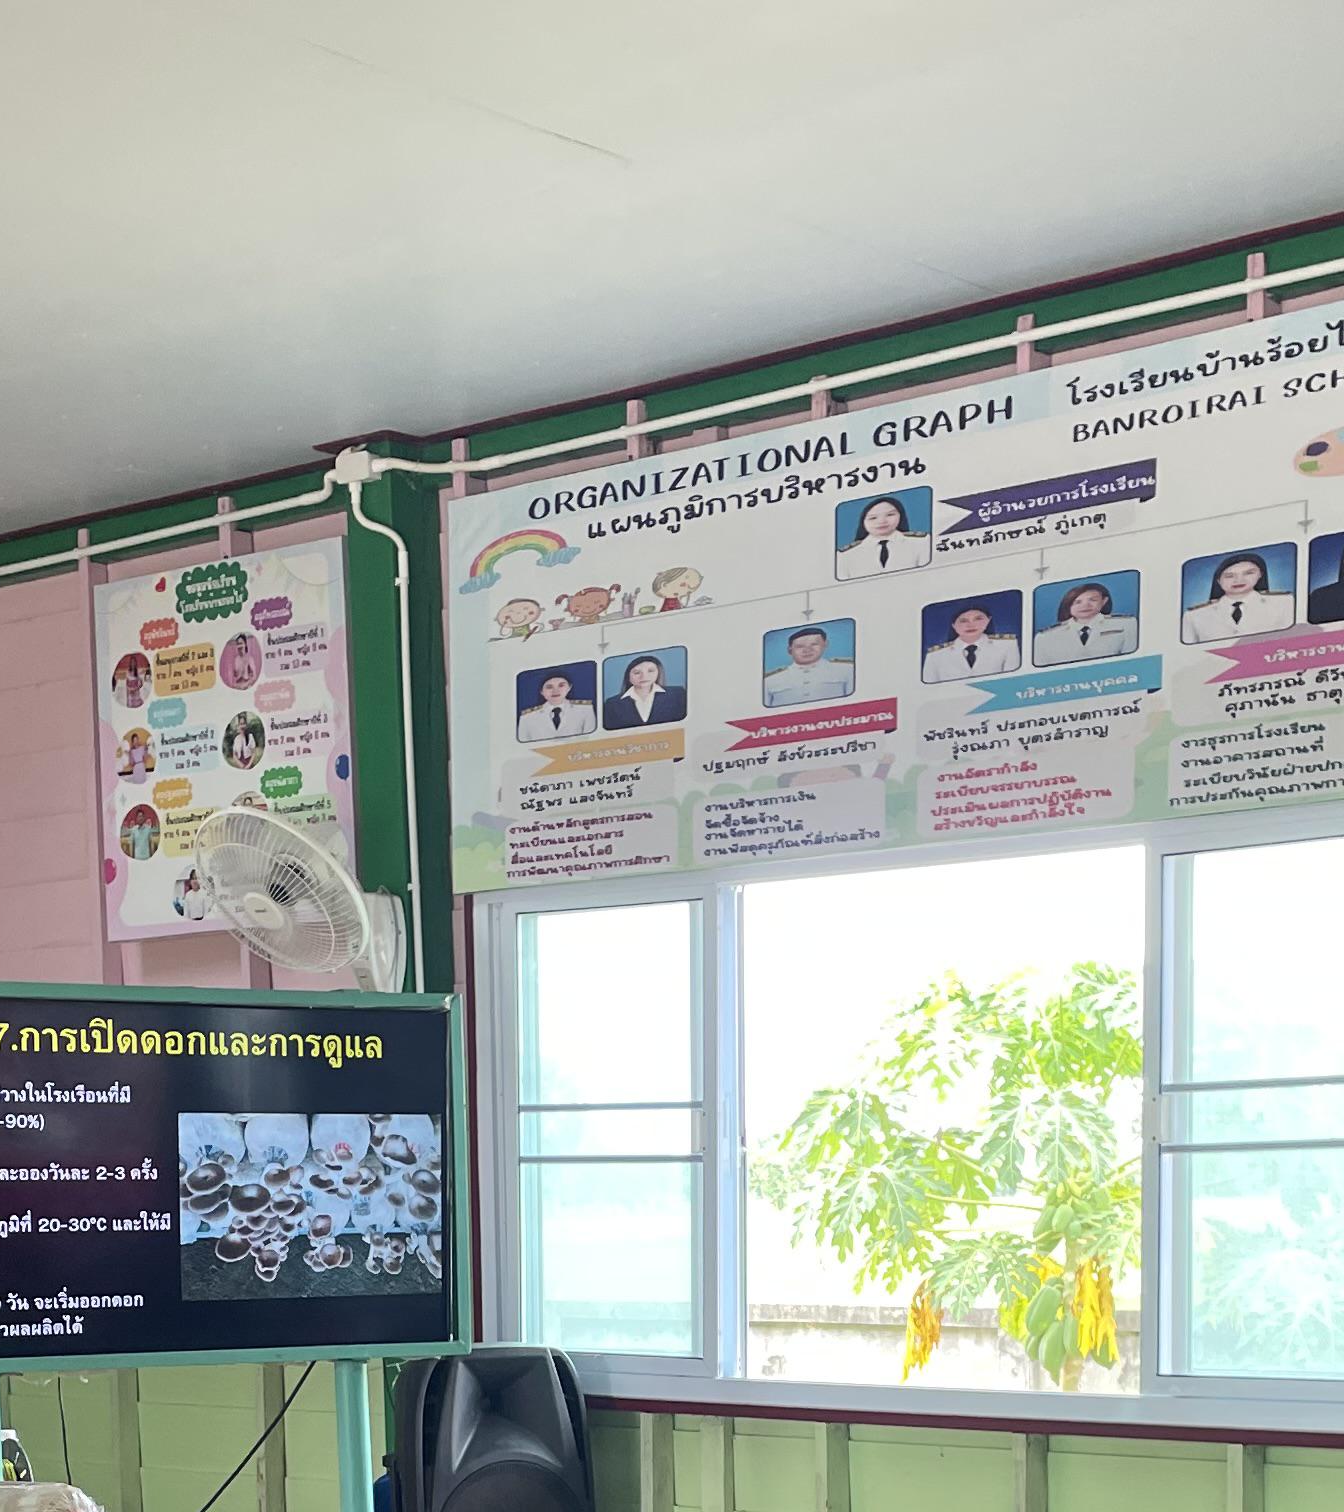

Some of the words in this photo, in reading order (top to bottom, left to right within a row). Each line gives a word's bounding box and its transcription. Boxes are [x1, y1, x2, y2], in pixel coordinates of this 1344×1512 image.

[1072, 384, 1267, 443] BANROIRAI
[528, 432, 855, 520] ORGANIZATIONAL
[872, 395, 1014, 449] GRAPH
[587, 456, 926, 539] แผนภูมิการบริหารงาน
[978, 475, 1156, 522] ผู้อำนวยการโรงเรียน
[96, 1166, 125, 1181] 2-3
[130, 1158, 158, 1181] ครั้ง
[38, 1217, 107, 1233] 20-30°C
[112, 1211, 171, 1232] และให้มี
[6, 1293, 29, 1311] วัน
[34, 1287, 144, 1310] จะเริ่มออกดอก
